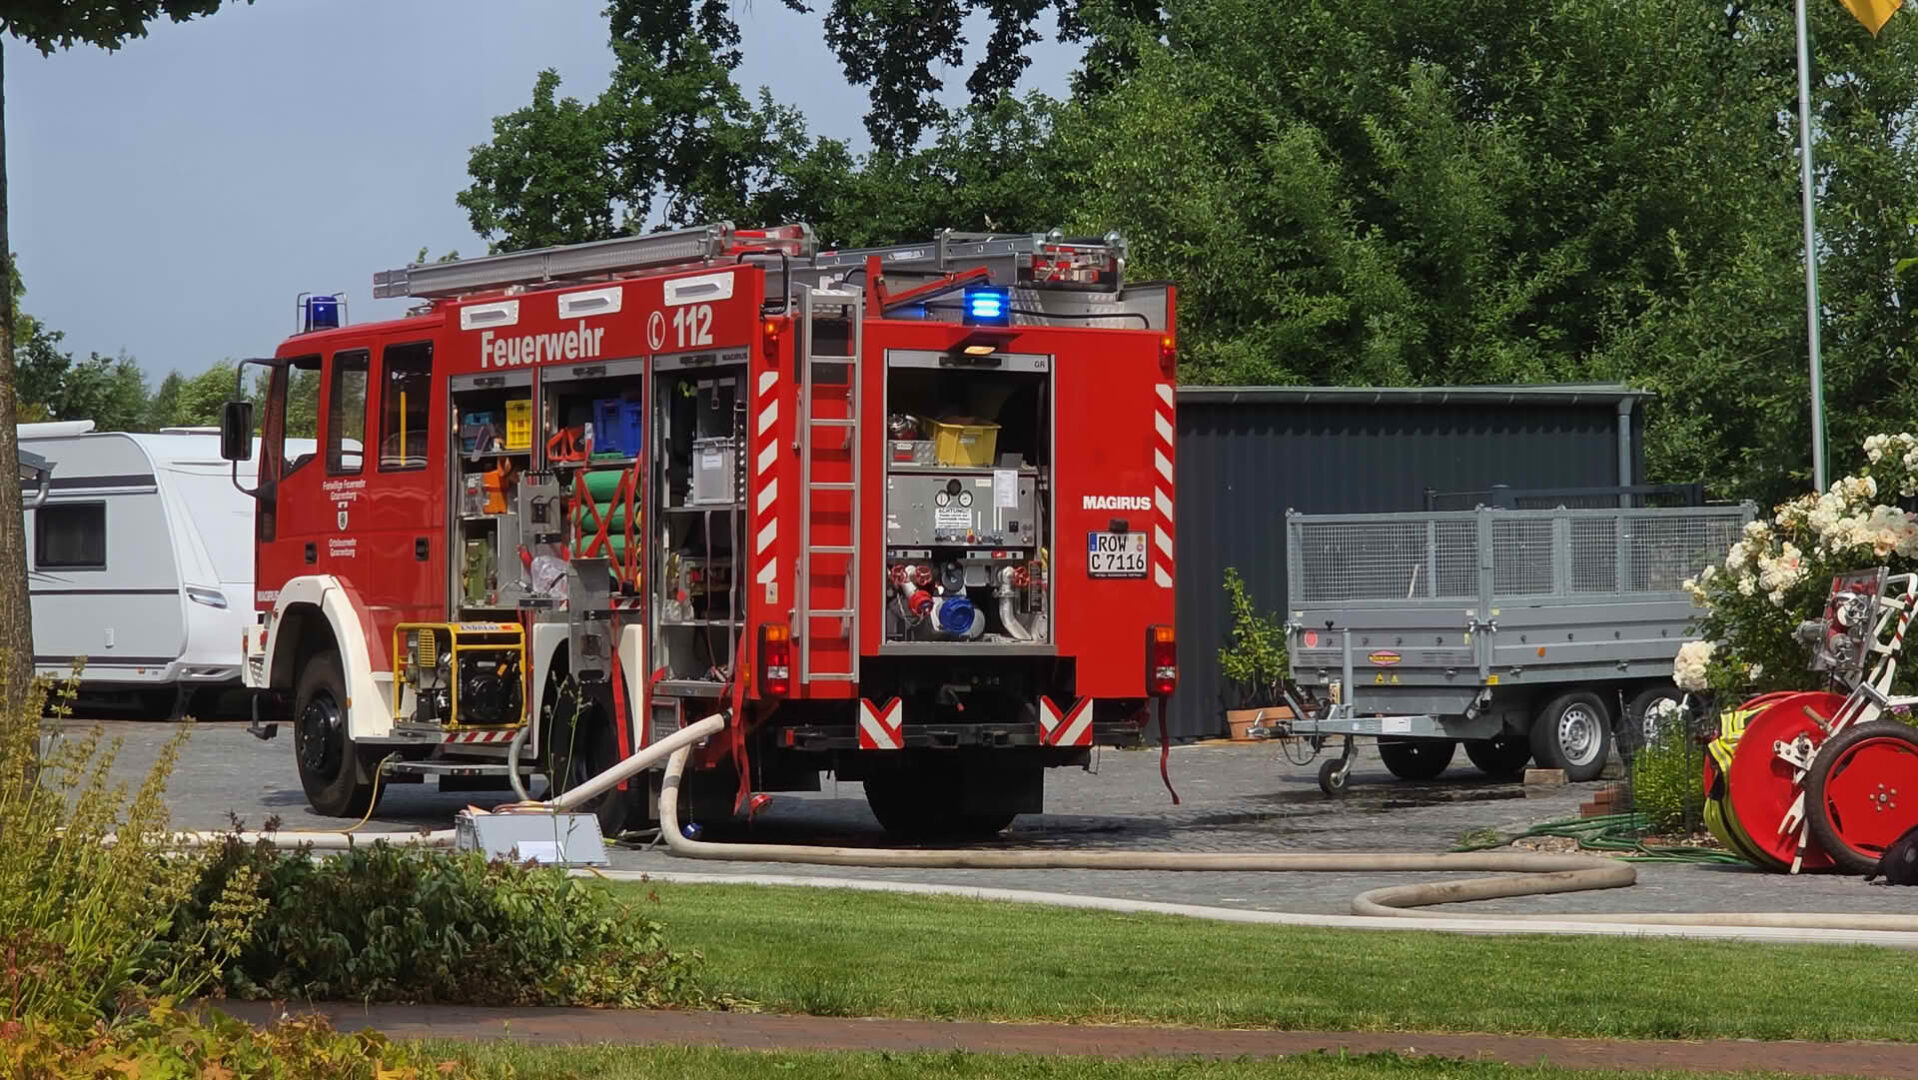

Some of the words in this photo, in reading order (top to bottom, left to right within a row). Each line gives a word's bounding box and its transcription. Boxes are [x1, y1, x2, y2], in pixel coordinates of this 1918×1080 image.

[672, 304, 713, 348] 112
[481, 319, 605, 368] Feuerwehr
[1082, 495, 1152, 511] MAGIRUS
[1098, 535, 1127, 552] ROW
[1091, 553, 1101, 570] C
[1106, 553, 1145, 570] 7116
